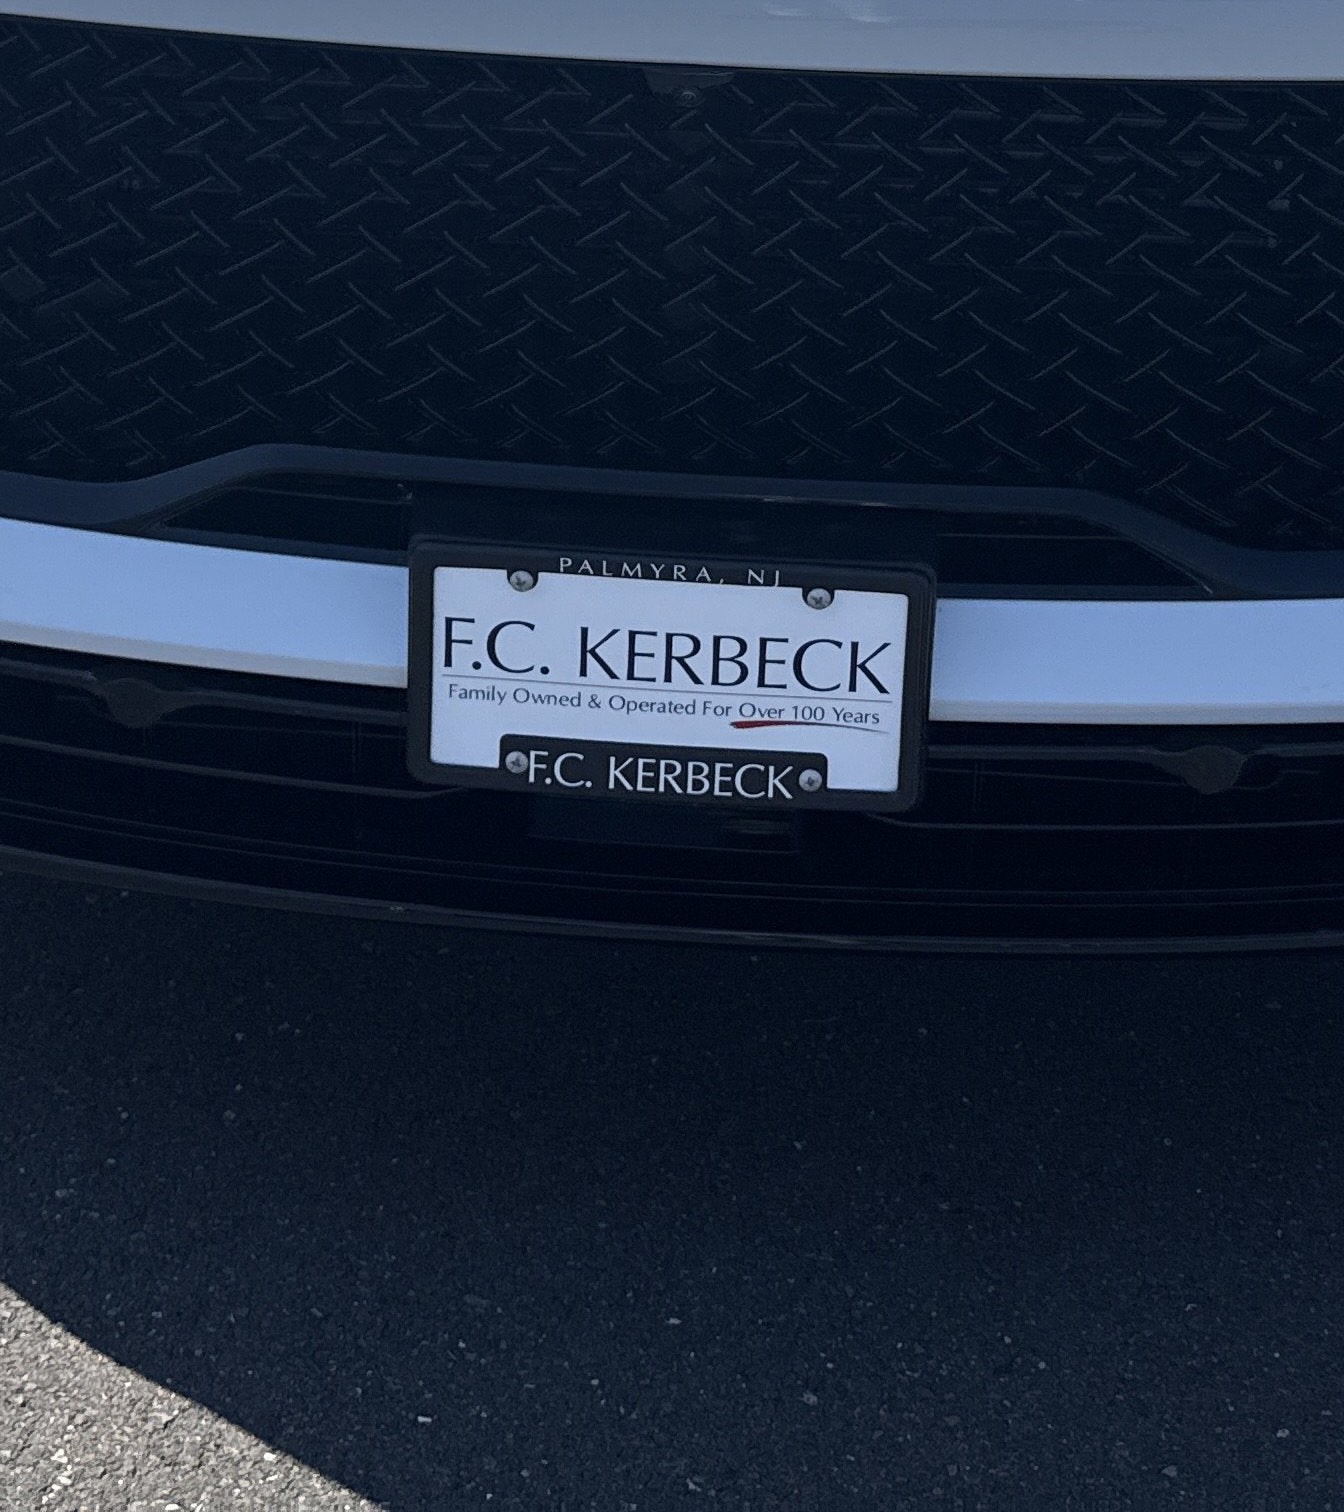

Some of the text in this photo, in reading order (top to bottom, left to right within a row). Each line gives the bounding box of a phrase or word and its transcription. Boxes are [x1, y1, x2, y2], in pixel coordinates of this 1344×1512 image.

[559, 557, 780, 588] PALMYRA, NJ
[442, 616, 892, 694] F.C. KERBECK
[448, 683, 881, 725] Family Owned & Operated For Over 100 Years
[527, 750, 794, 799] F.C. KERBECK
